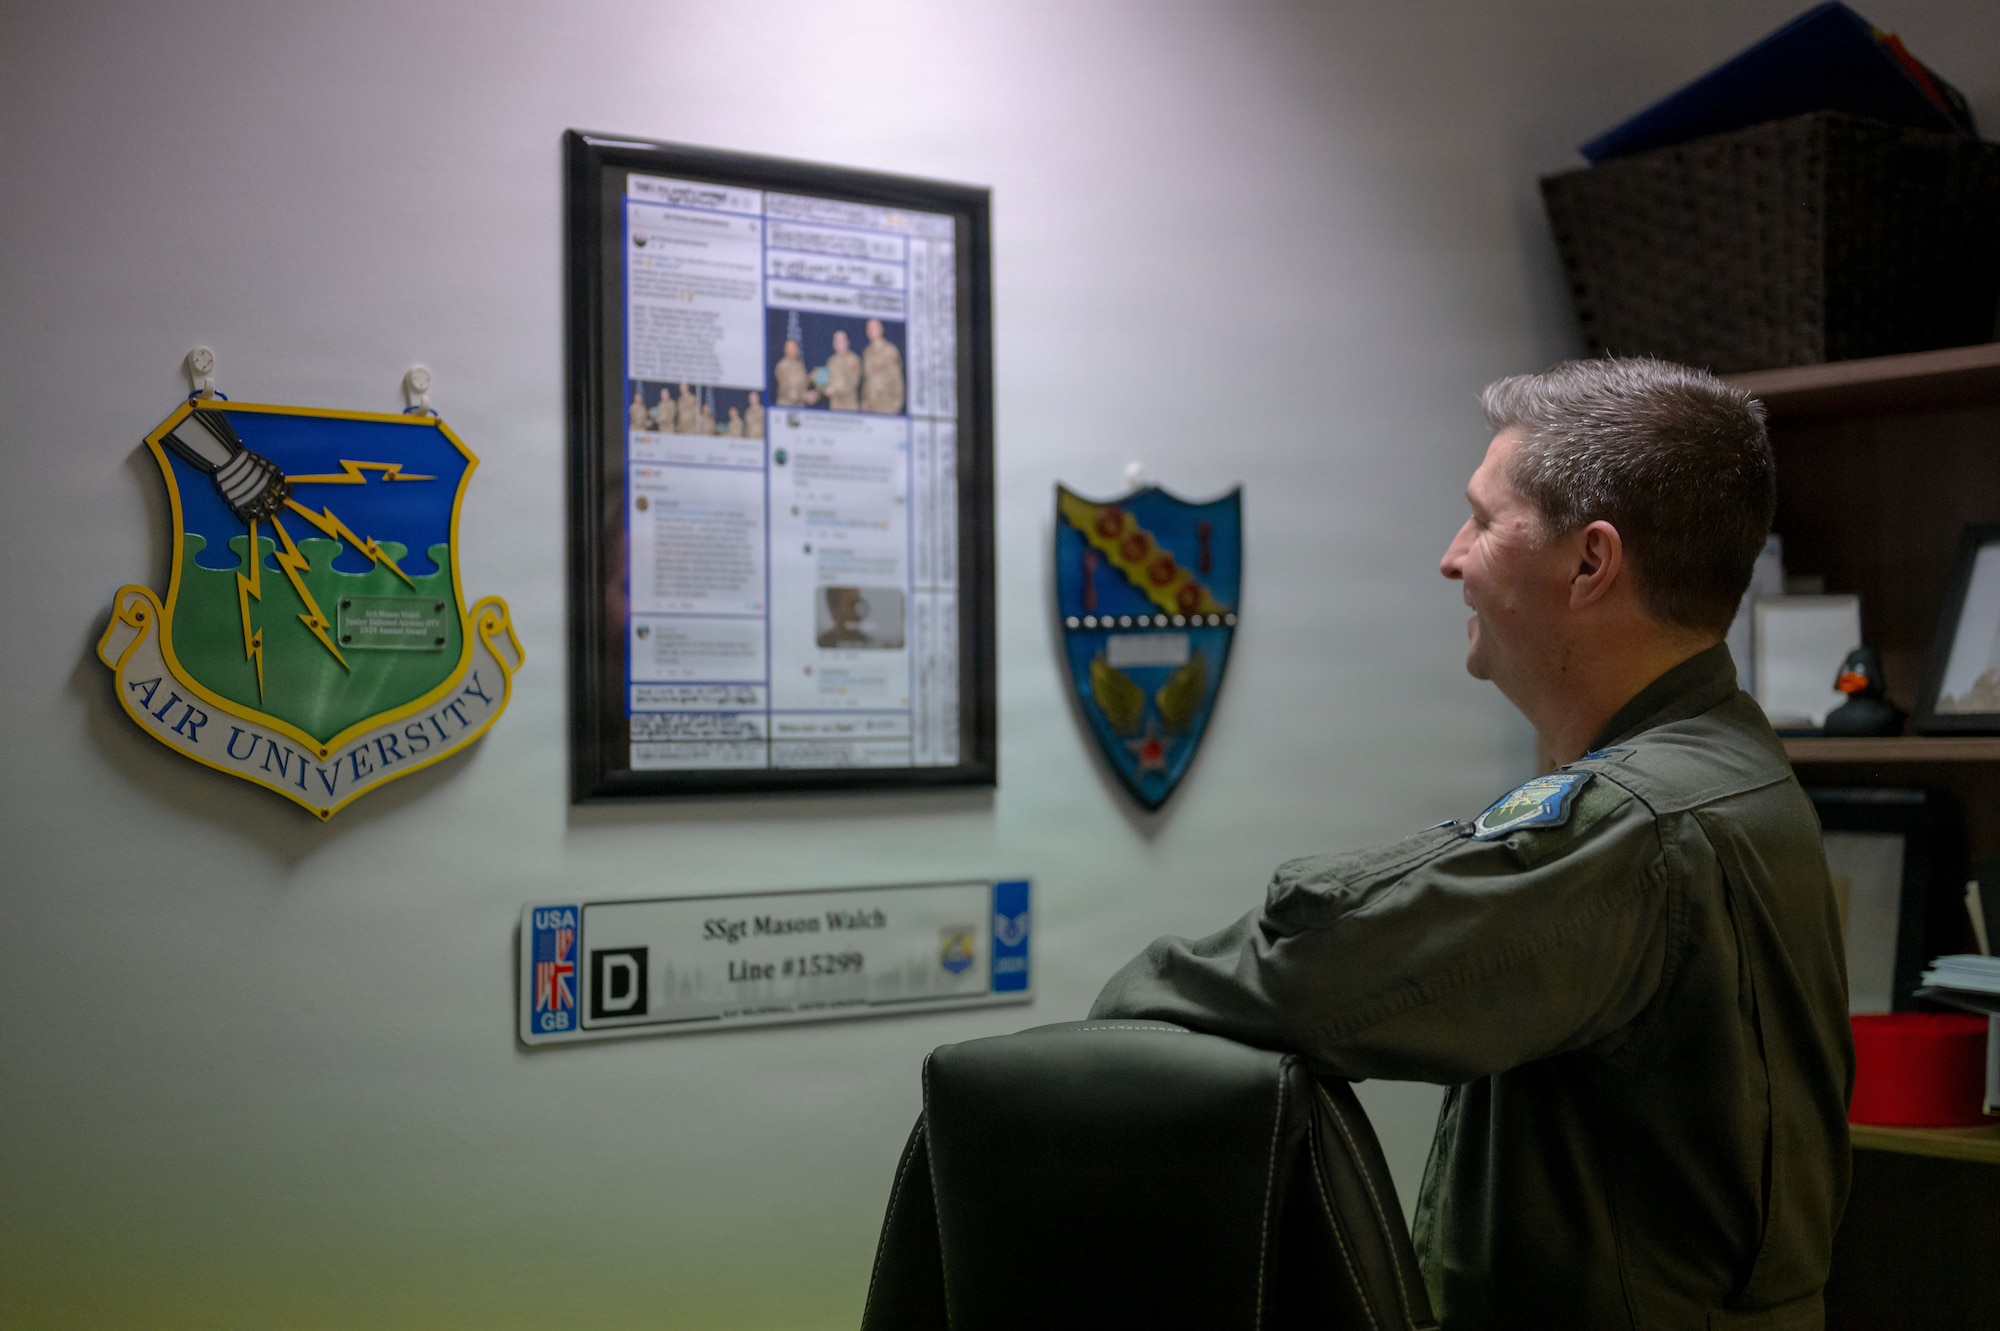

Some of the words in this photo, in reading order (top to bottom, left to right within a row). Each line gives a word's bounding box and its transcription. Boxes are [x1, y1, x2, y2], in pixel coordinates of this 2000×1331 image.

[129, 676, 209, 742] AIR
[226, 671, 493, 797] UNIVERSITY
[536, 910, 577, 930] USA
[703, 917, 748, 944] SSgt
[754, 914, 821, 937] Mason
[826, 907, 887, 932] Walch
[602, 953, 639, 1012] D
[728, 959, 775, 983] Line
[782, 951, 864, 978] #15299
[541, 1011, 570, 1032] GB
